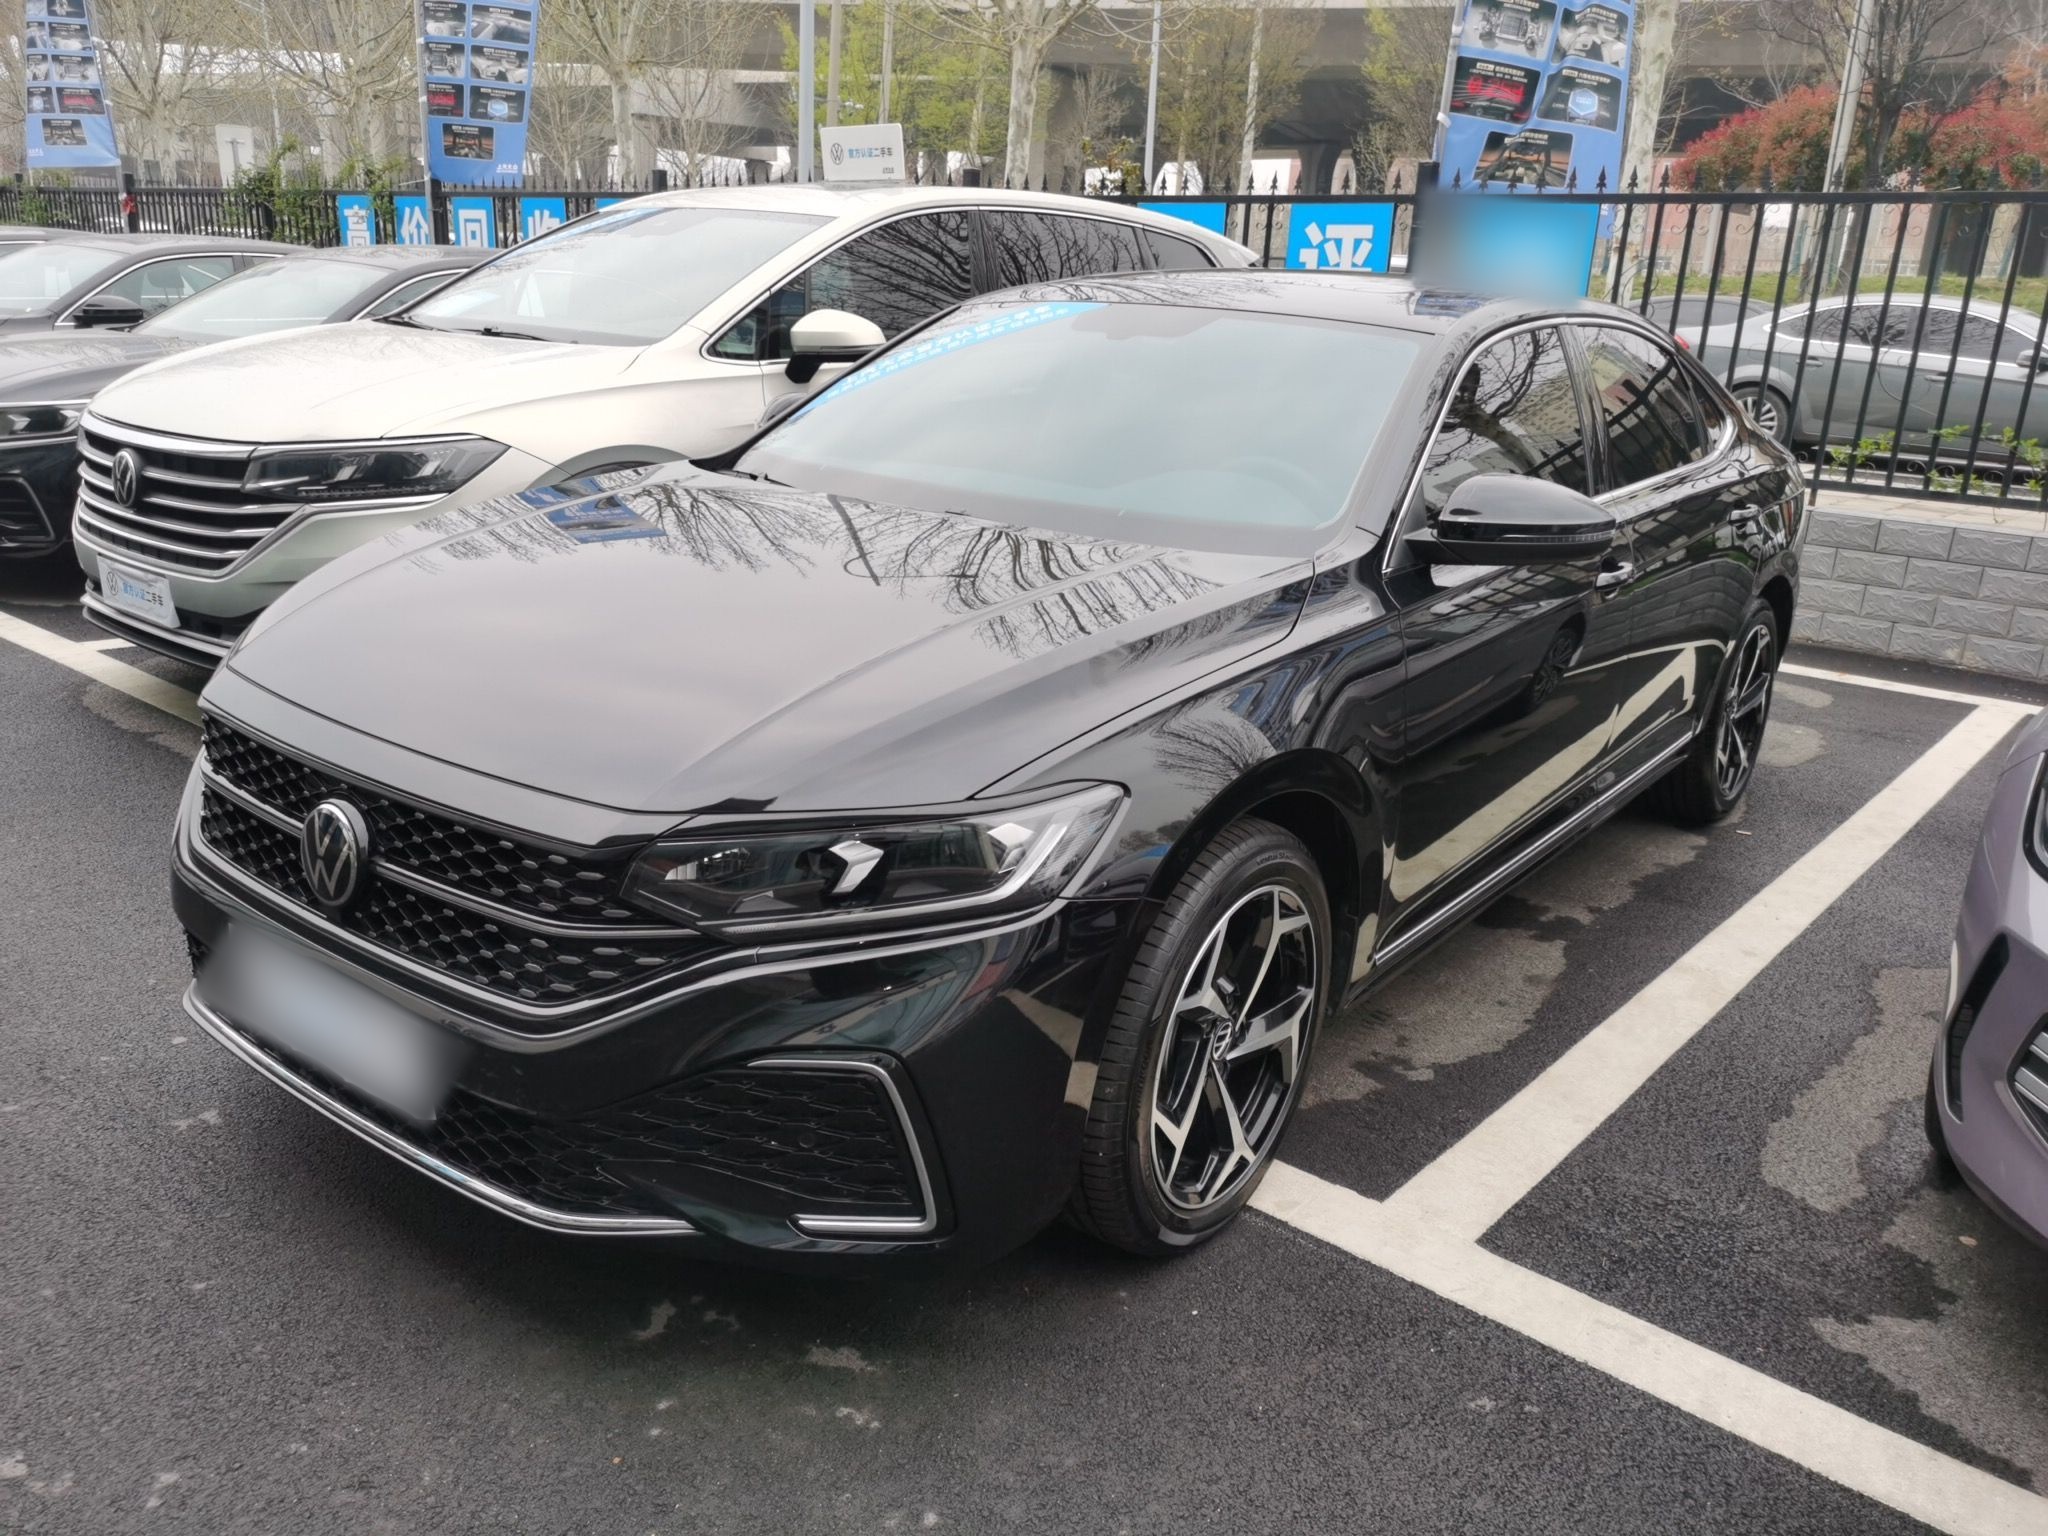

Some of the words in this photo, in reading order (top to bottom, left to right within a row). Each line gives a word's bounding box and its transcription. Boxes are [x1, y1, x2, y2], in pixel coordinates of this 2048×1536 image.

[848, 147, 893, 159] 官方认证二手车
[123, 581, 164, 606] 官方认证二手车
